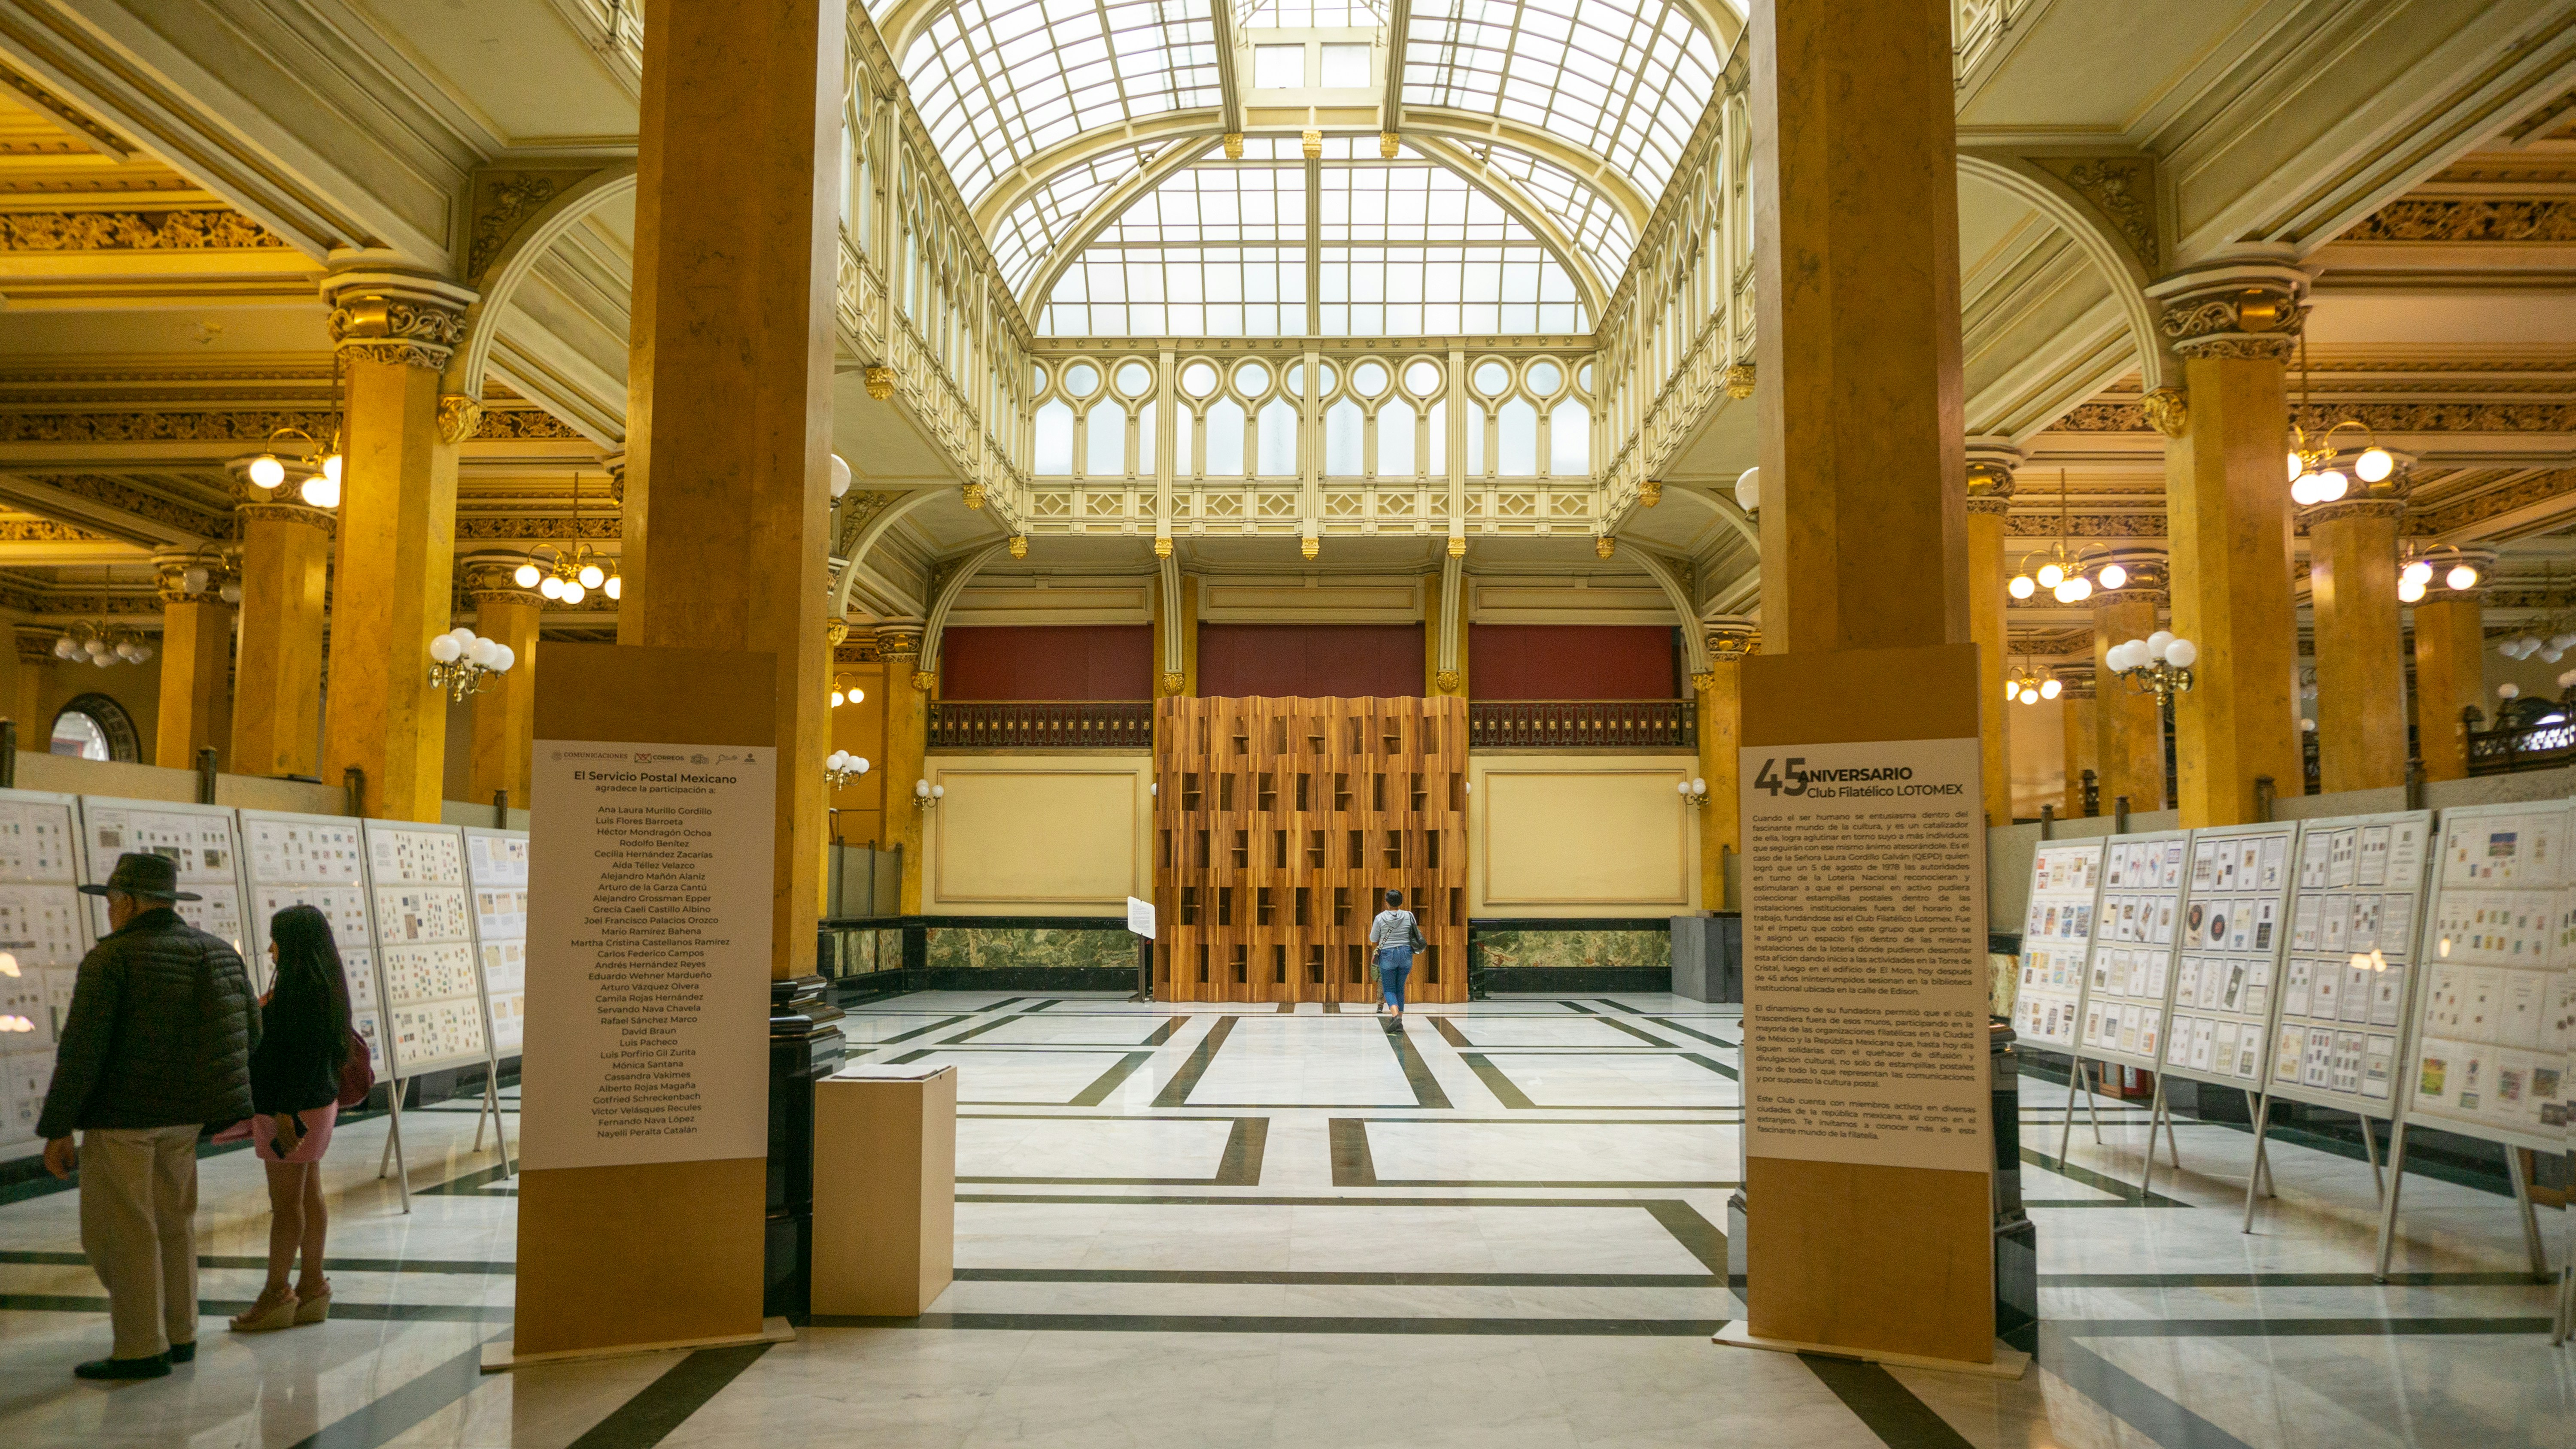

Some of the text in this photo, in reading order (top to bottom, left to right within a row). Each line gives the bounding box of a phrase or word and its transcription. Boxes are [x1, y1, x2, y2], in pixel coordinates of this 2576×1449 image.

[574, 770, 737, 784] El Servicio Postal Mexicano
[1754, 758, 1808, 797] 45
[1798, 767, 1913, 783] ANIVERSARIO
[595, 785, 637, 793] agradece
[649, 786, 707, 794] participación
[1807, 784, 1964, 798] Club Filatélico LOTOMEX
[630, 829, 681, 837] Mondragón
[594, 850, 623, 858] Cecilia
[600, 872, 644, 881] Alejandro
[593, 894, 636, 903] Alejandro
[686, 895, 711, 903] Epper
[668, 949, 704, 958] Campos
[680, 961, 706, 969] Reyes
[588, 973, 627, 981] Eduardo
[629, 994, 653, 1003] Rojas
[1765, 1004, 1810, 1012] dinamismo
[1839, 1007, 1882, 1015] fundadora
[600, 1051, 619, 1059] Luis
[604, 1073, 650, 1081] Cassandra
[635, 1084, 658, 1092] Rojas
[661, 1082, 696, 1091] Magaña
[633, 1092, 701, 1102] Schreckenbach
[598, 1118, 641, 1126] Fernando
[1819, 1119, 1857, 1128] invitamos
[630, 1128, 662, 1136] Peralta
[664, 1126, 697, 1134] Catalán
